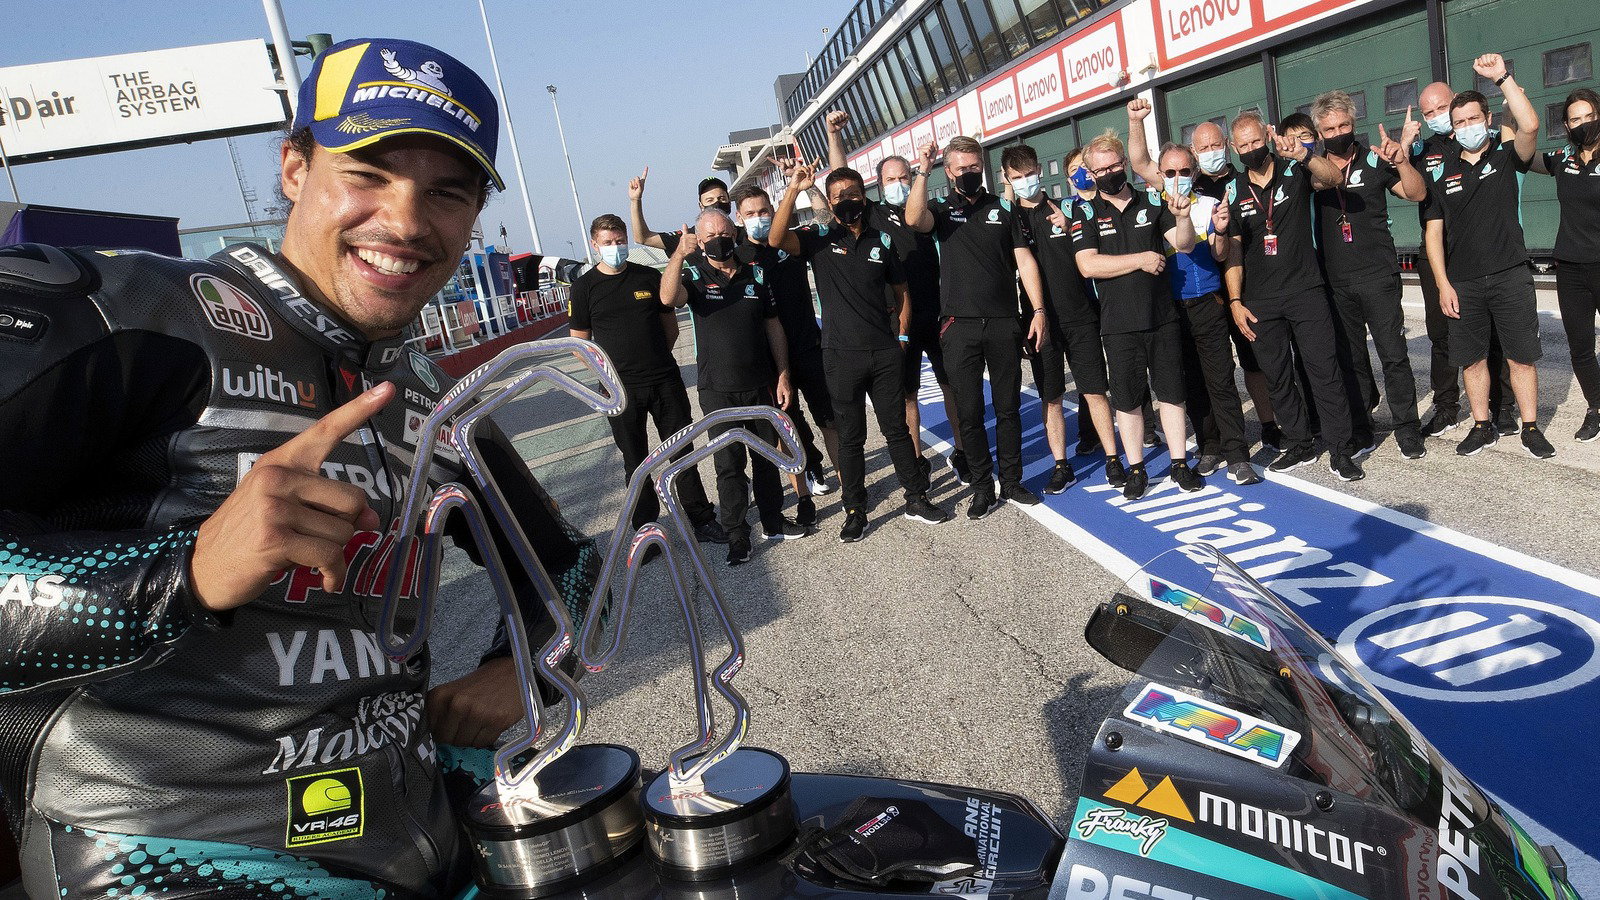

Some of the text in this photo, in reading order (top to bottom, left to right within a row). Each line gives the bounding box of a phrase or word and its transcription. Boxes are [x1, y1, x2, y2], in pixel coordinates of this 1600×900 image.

[1168, 0, 1240, 41] Lenovo
[109, 71, 151, 88] THE
[1069, 46, 1114, 84] Lenovo
[117, 81, 197, 104] AIRBAG
[119, 95, 200, 118] SYSTEM
[353, 85, 480, 132] MICHELIN
[984, 94, 1013, 120] Lenovo
[1021, 73, 1057, 104] Lenovo
[935, 120, 958, 140] Lenovo
[228, 247, 356, 344] DAINESE
[213, 302, 262, 338] agv
[1149, 578, 1267, 647] MRA
[1130, 688, 1285, 762] MRA
[974, 802, 991, 877] INERNATIONAL
[985, 804, 1002, 880] CIRCUIT
[1079, 809, 1167, 855] Franky
[1200, 791, 1373, 875] monitor
